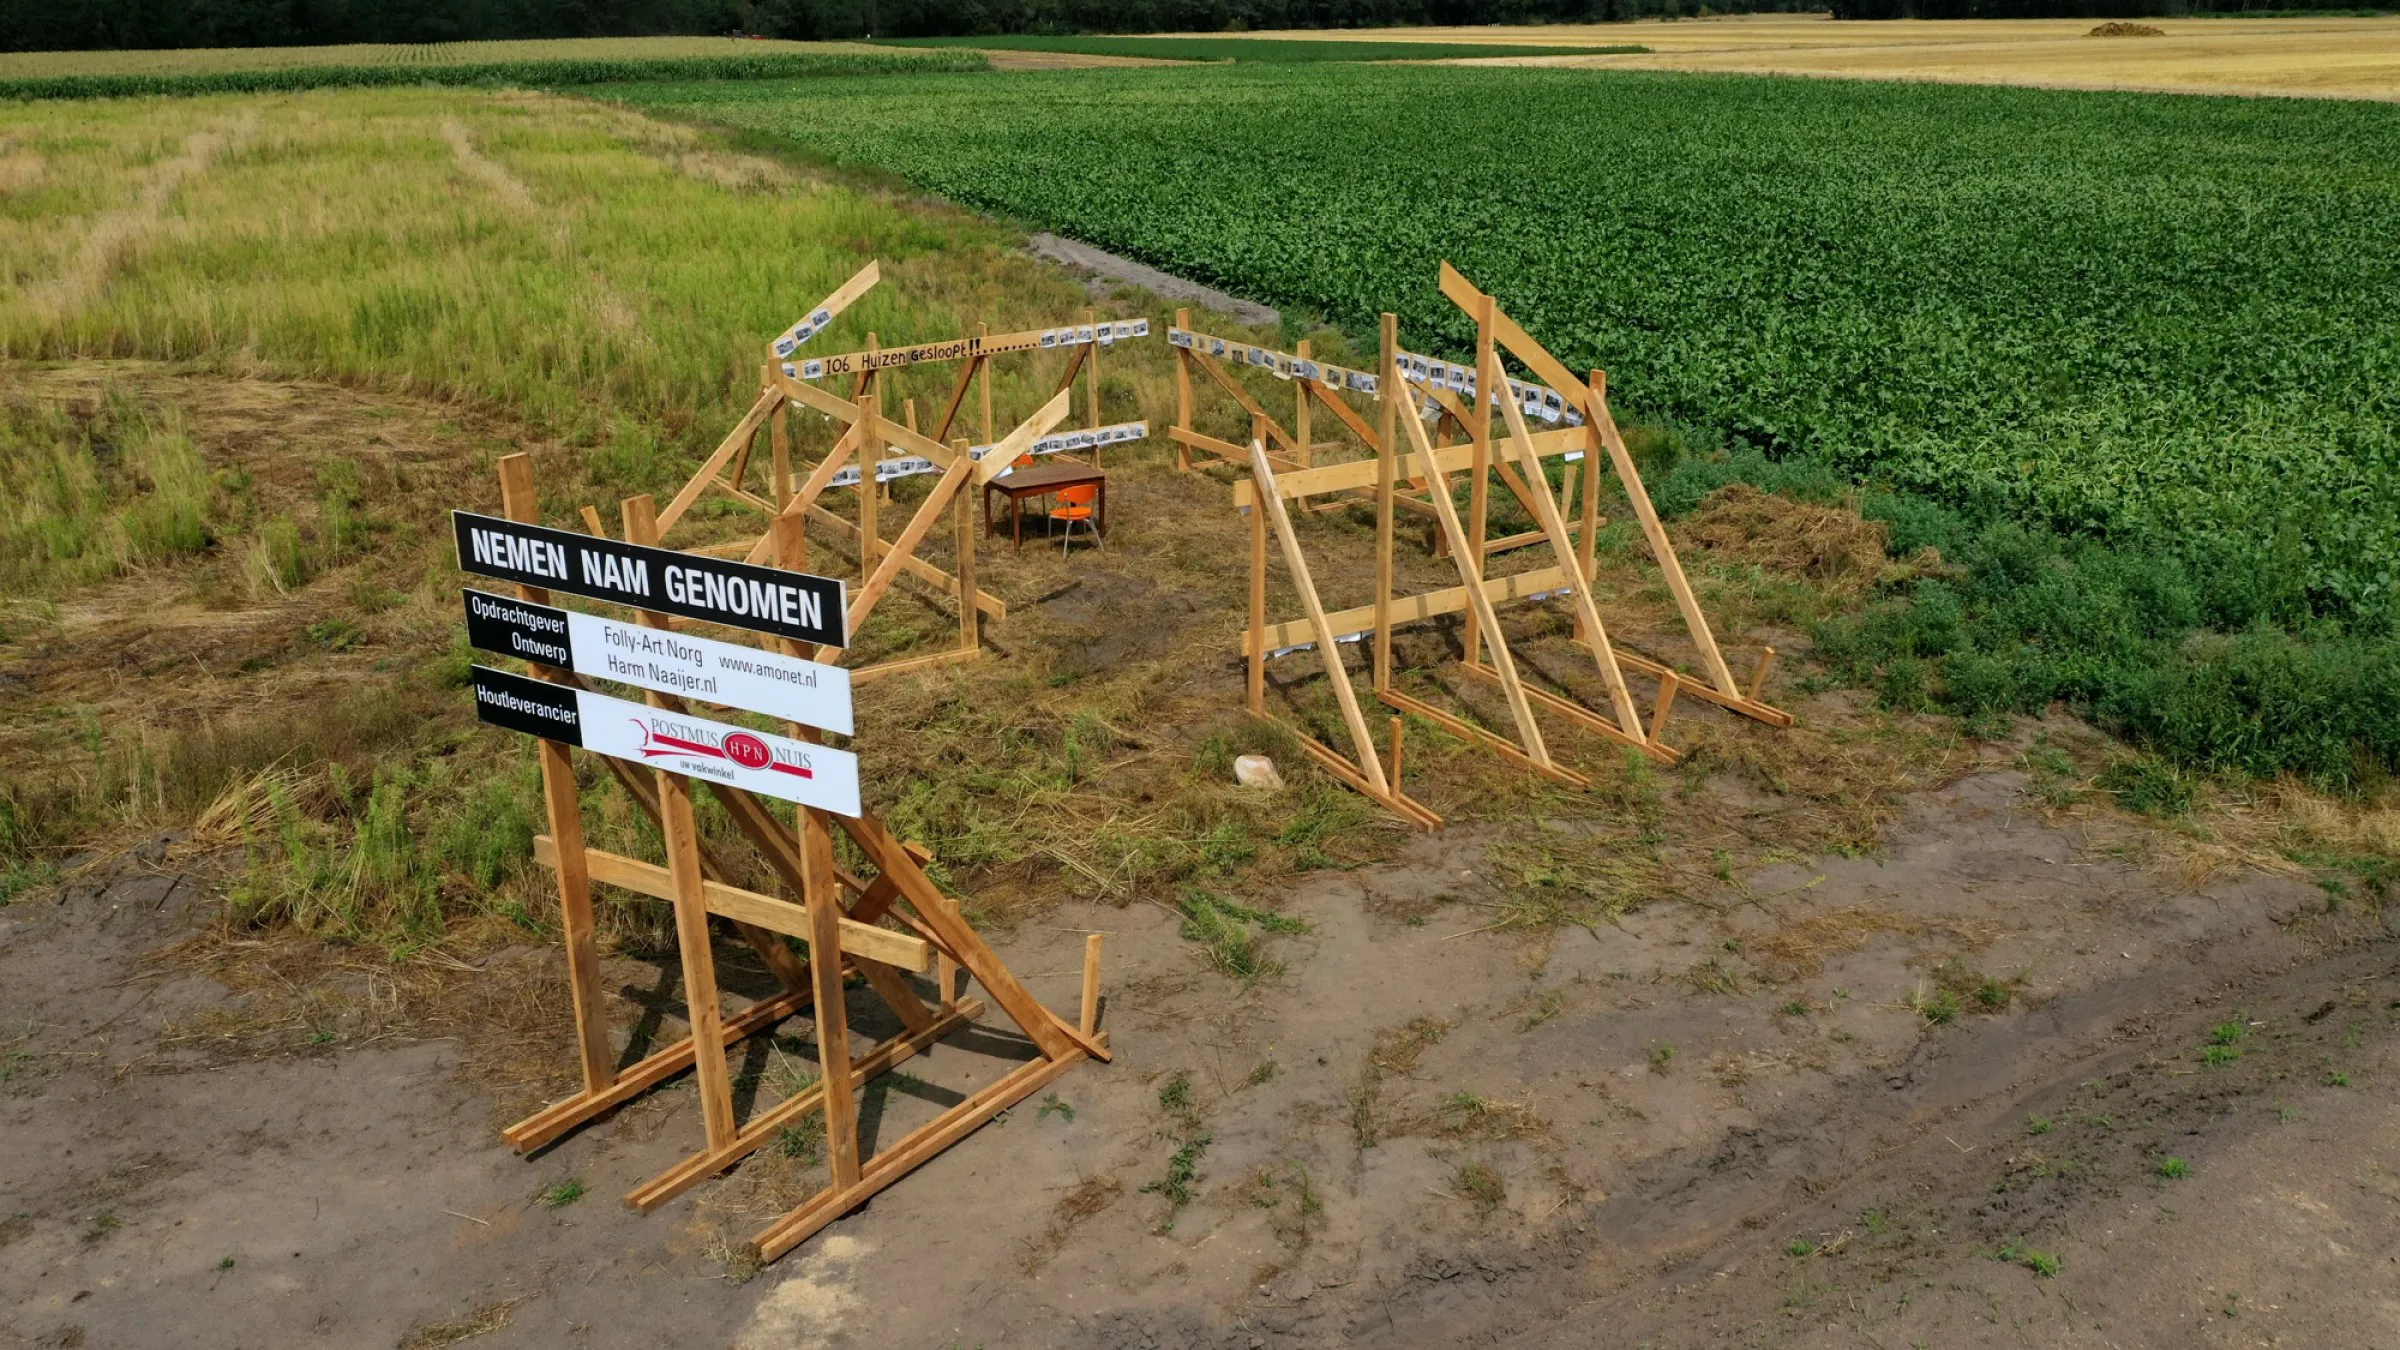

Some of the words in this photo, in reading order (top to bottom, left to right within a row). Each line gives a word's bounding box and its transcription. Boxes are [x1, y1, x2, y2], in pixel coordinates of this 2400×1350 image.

[826, 356, 850, 375] 106
[861, 352, 906, 369] Huizen
[471, 527, 568, 581] NEMEN
[580, 549, 650, 597] NAM
[664, 564, 823, 631] GENOMEN
[472, 596, 565, 634] Opdrachtgever
[511, 632, 567, 665] Ontwerp
[604, 626, 664, 655] Folly-Art
[667, 639, 703, 668] Norg
[719, 655, 817, 689] www.amonet.nl
[608, 654, 645, 678] Harm
[649, 663, 717, 694] Naaijer.nl
[477, 684, 577, 726] Houtleverancier
[651, 718, 720, 747] POSTMUS
[730, 741, 763, 762] HPN
[775, 746, 812, 769] NUIS
[680, 760, 691, 769] uw
[691, 762, 735, 780] vakwinkel
